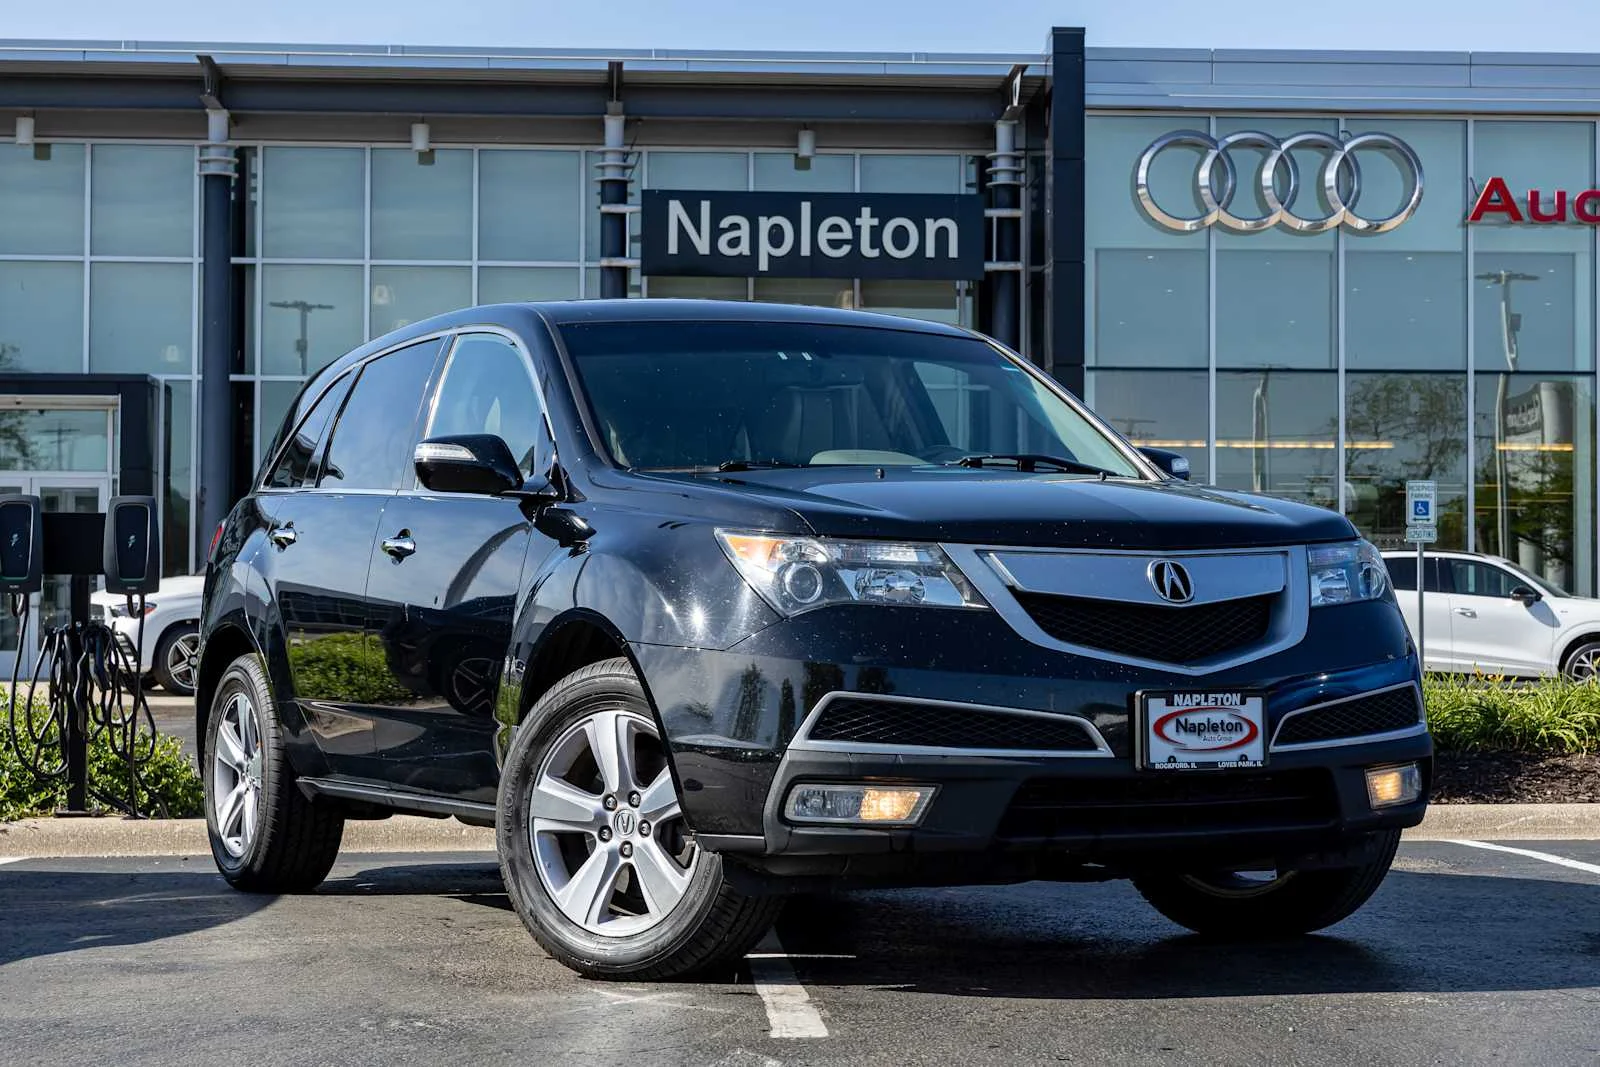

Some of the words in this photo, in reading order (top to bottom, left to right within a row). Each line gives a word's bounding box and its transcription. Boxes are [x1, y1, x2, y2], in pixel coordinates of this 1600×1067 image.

[667, 199, 959, 272] Napleton
[1174, 693, 1241, 706] NAPLETON
[1175, 717, 1243, 736] Napleton
